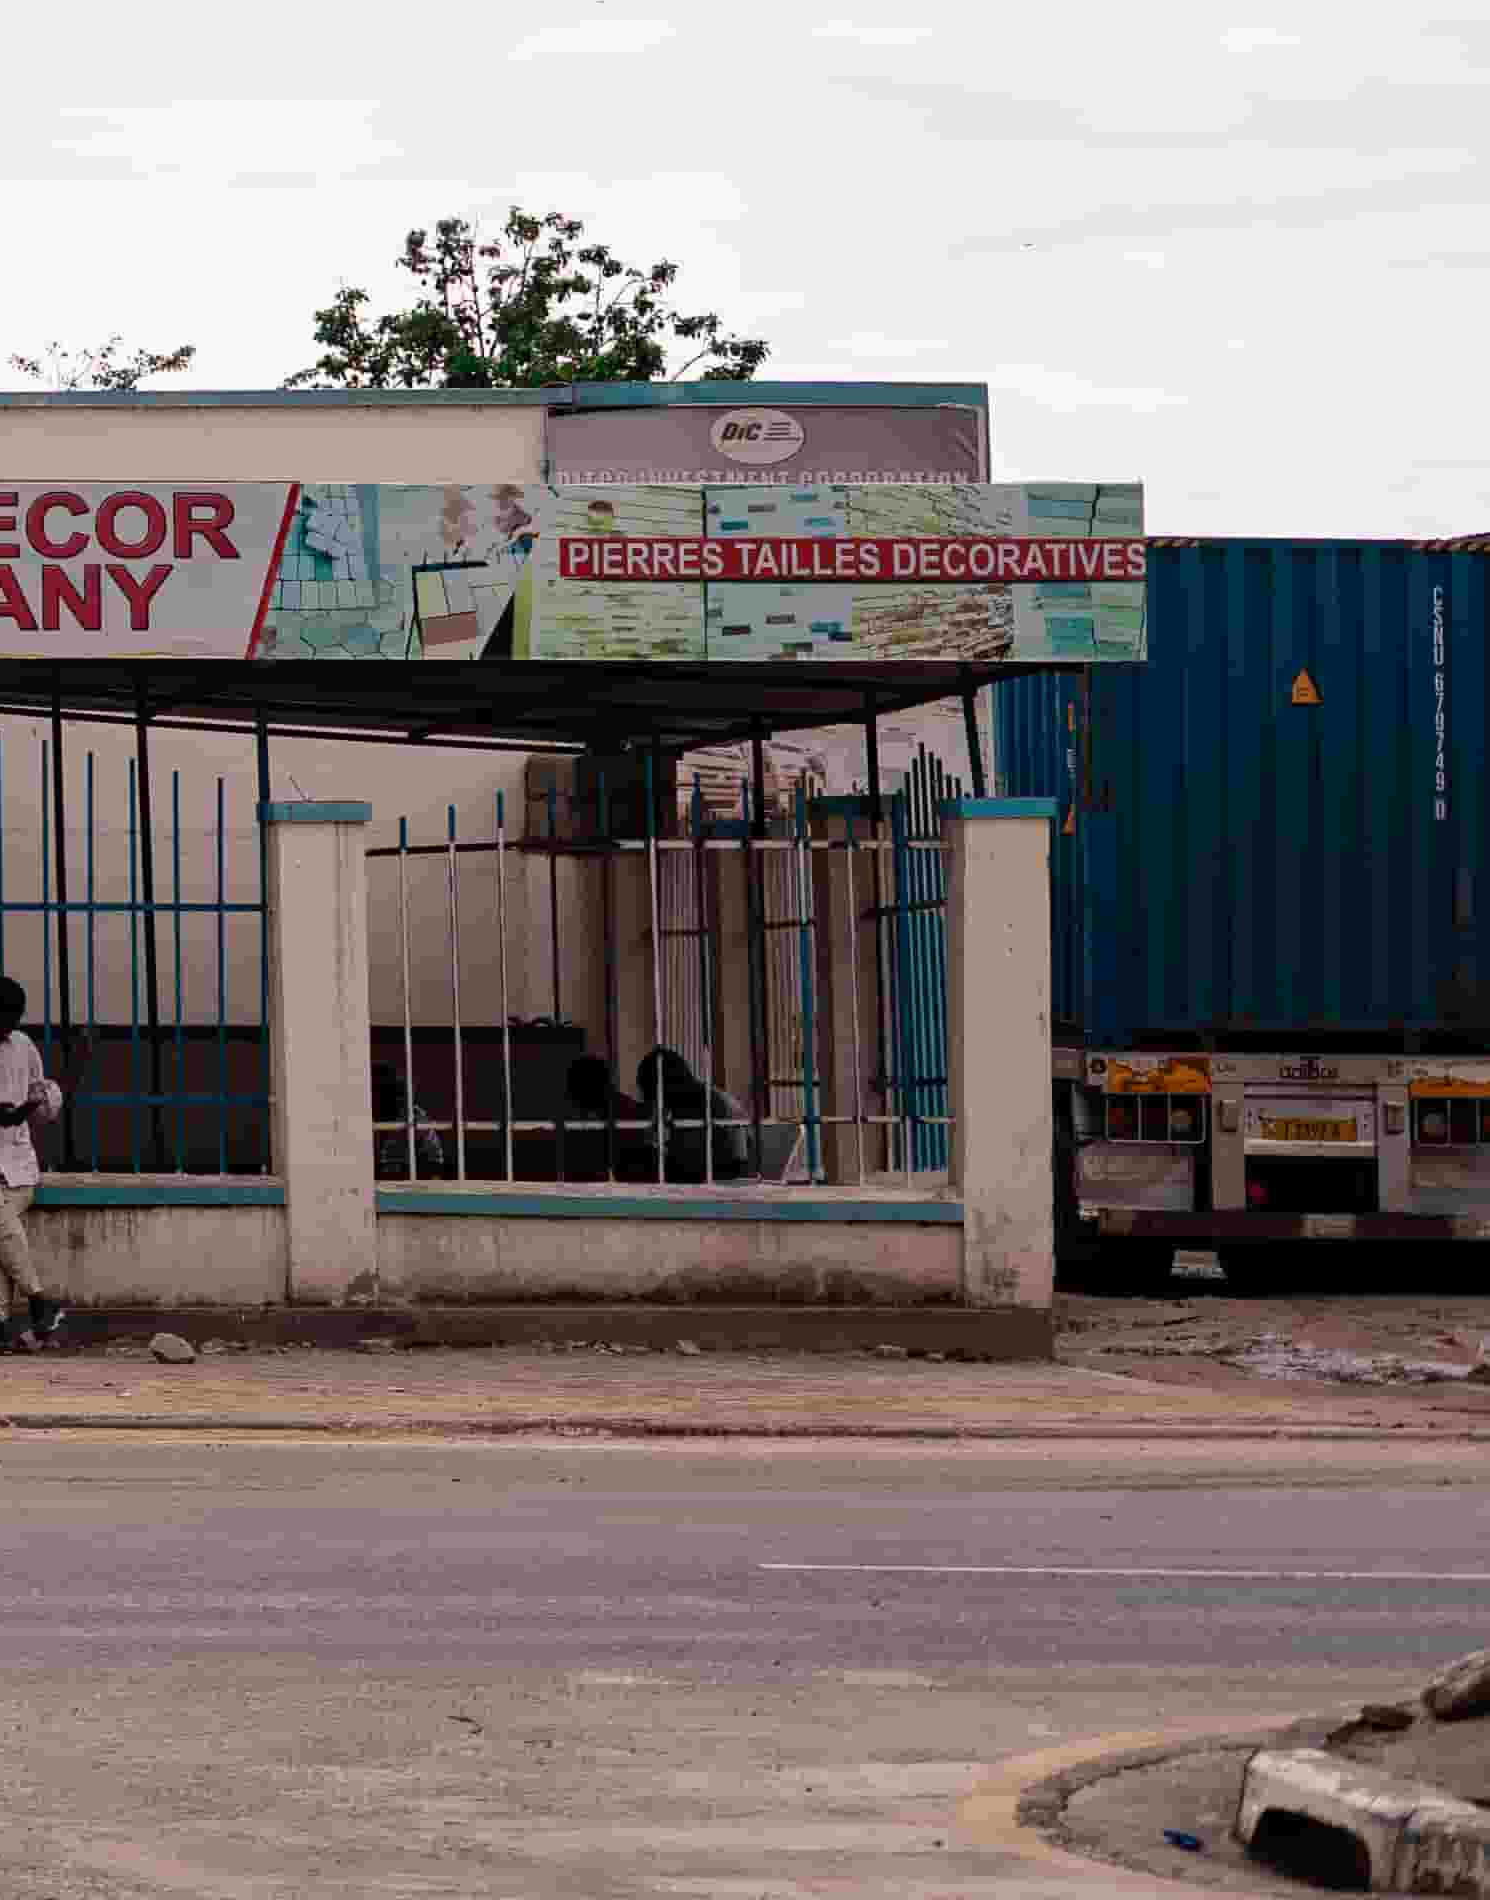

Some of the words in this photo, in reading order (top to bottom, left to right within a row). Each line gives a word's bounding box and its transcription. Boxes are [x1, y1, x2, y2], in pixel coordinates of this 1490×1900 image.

[567, 542, 724, 577] PIERRES
[733, 542, 881, 577] TAILLES
[892, 543, 1147, 578] DECORATIVES
